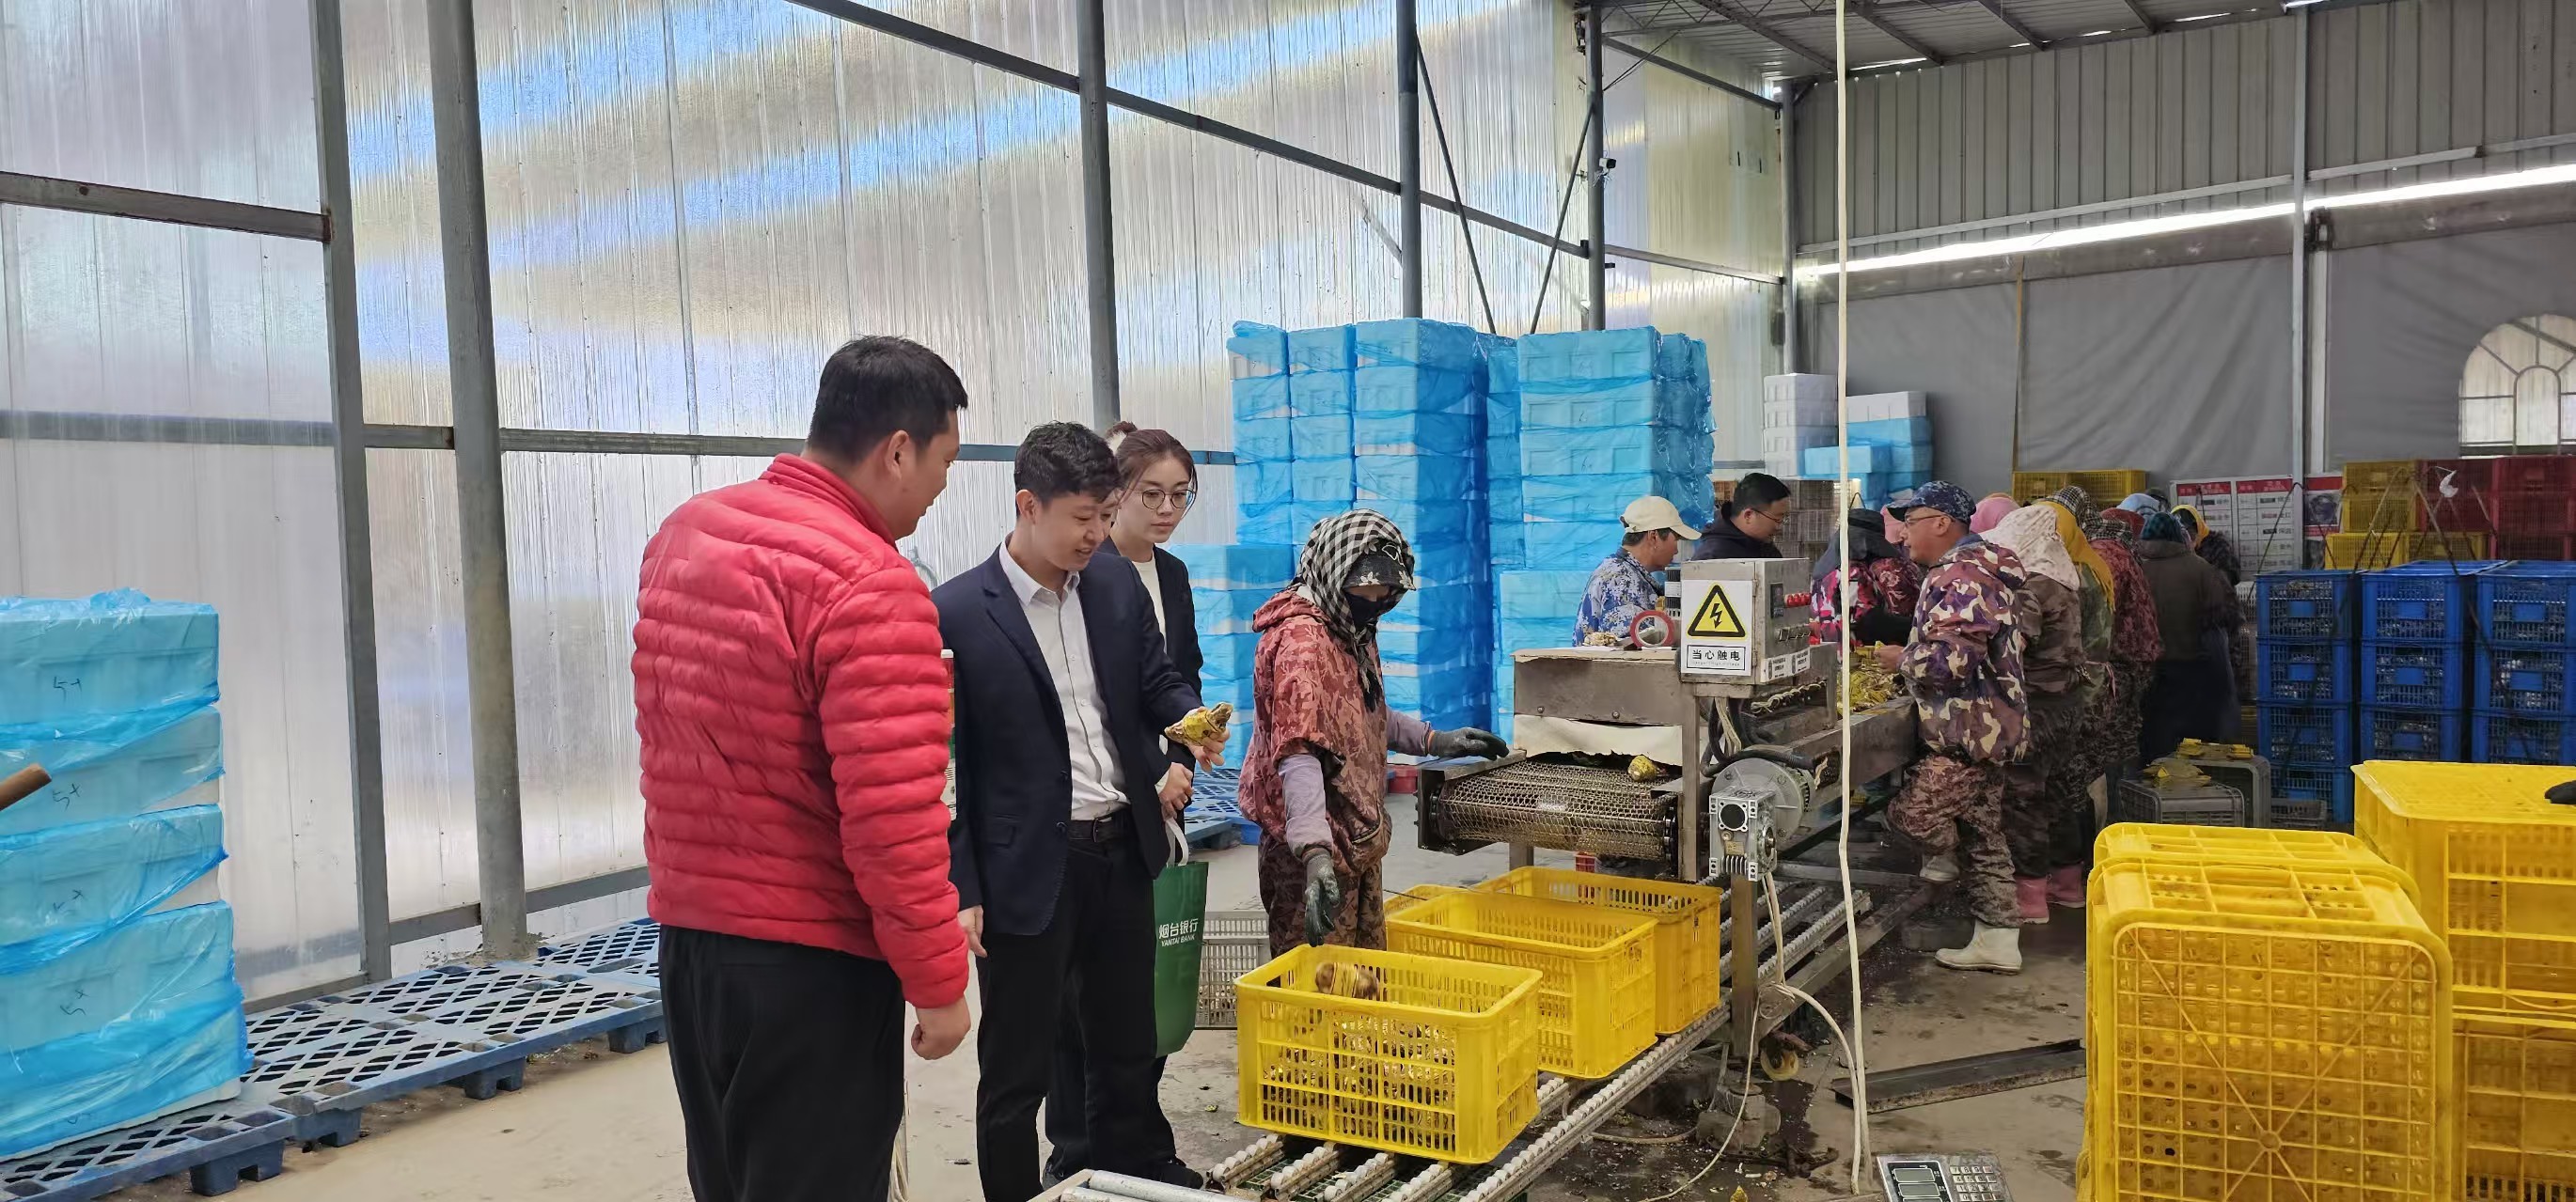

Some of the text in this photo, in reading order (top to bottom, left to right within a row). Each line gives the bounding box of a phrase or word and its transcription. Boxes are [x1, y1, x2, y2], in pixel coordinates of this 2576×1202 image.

[1692, 649, 1740, 661] 当心触电
[1158, 918, 1199, 939] 烟台银行
[1161, 933, 1195, 946] YANTAI BANK
